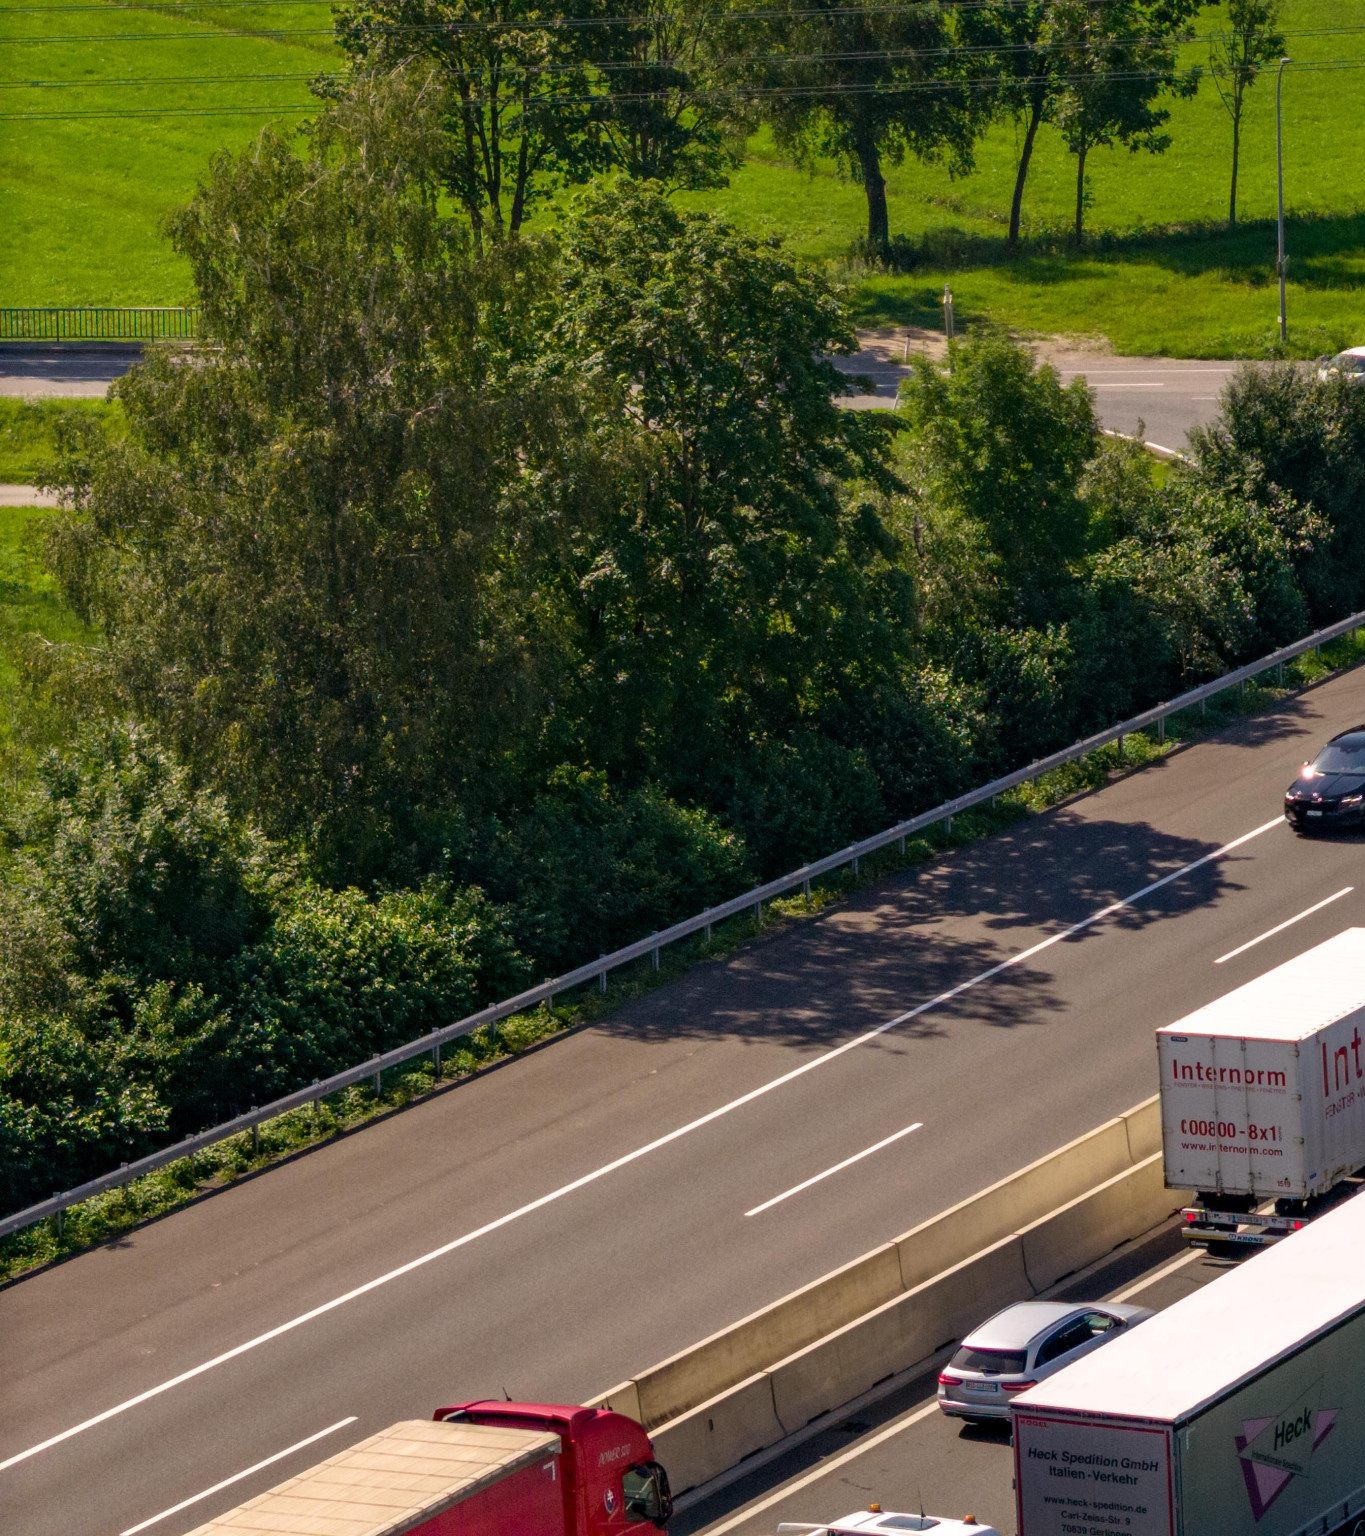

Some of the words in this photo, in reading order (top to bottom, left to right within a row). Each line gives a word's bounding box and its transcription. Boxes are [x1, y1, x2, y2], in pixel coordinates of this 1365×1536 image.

[1172, 1059, 1286, 1086] Internorm
[1181, 1142, 1283, 1156] www.internorm.com
[1274, 1407, 1312, 1451] Heck
[1028, 1447, 1058, 1460] Heck
[1061, 1450, 1118, 1469] Spedition
[1121, 1457, 1159, 1472] GmbH
[1044, 1495, 1147, 1514] www.heck-spedition.de
[1124, 1517, 1131, 1526] 9
